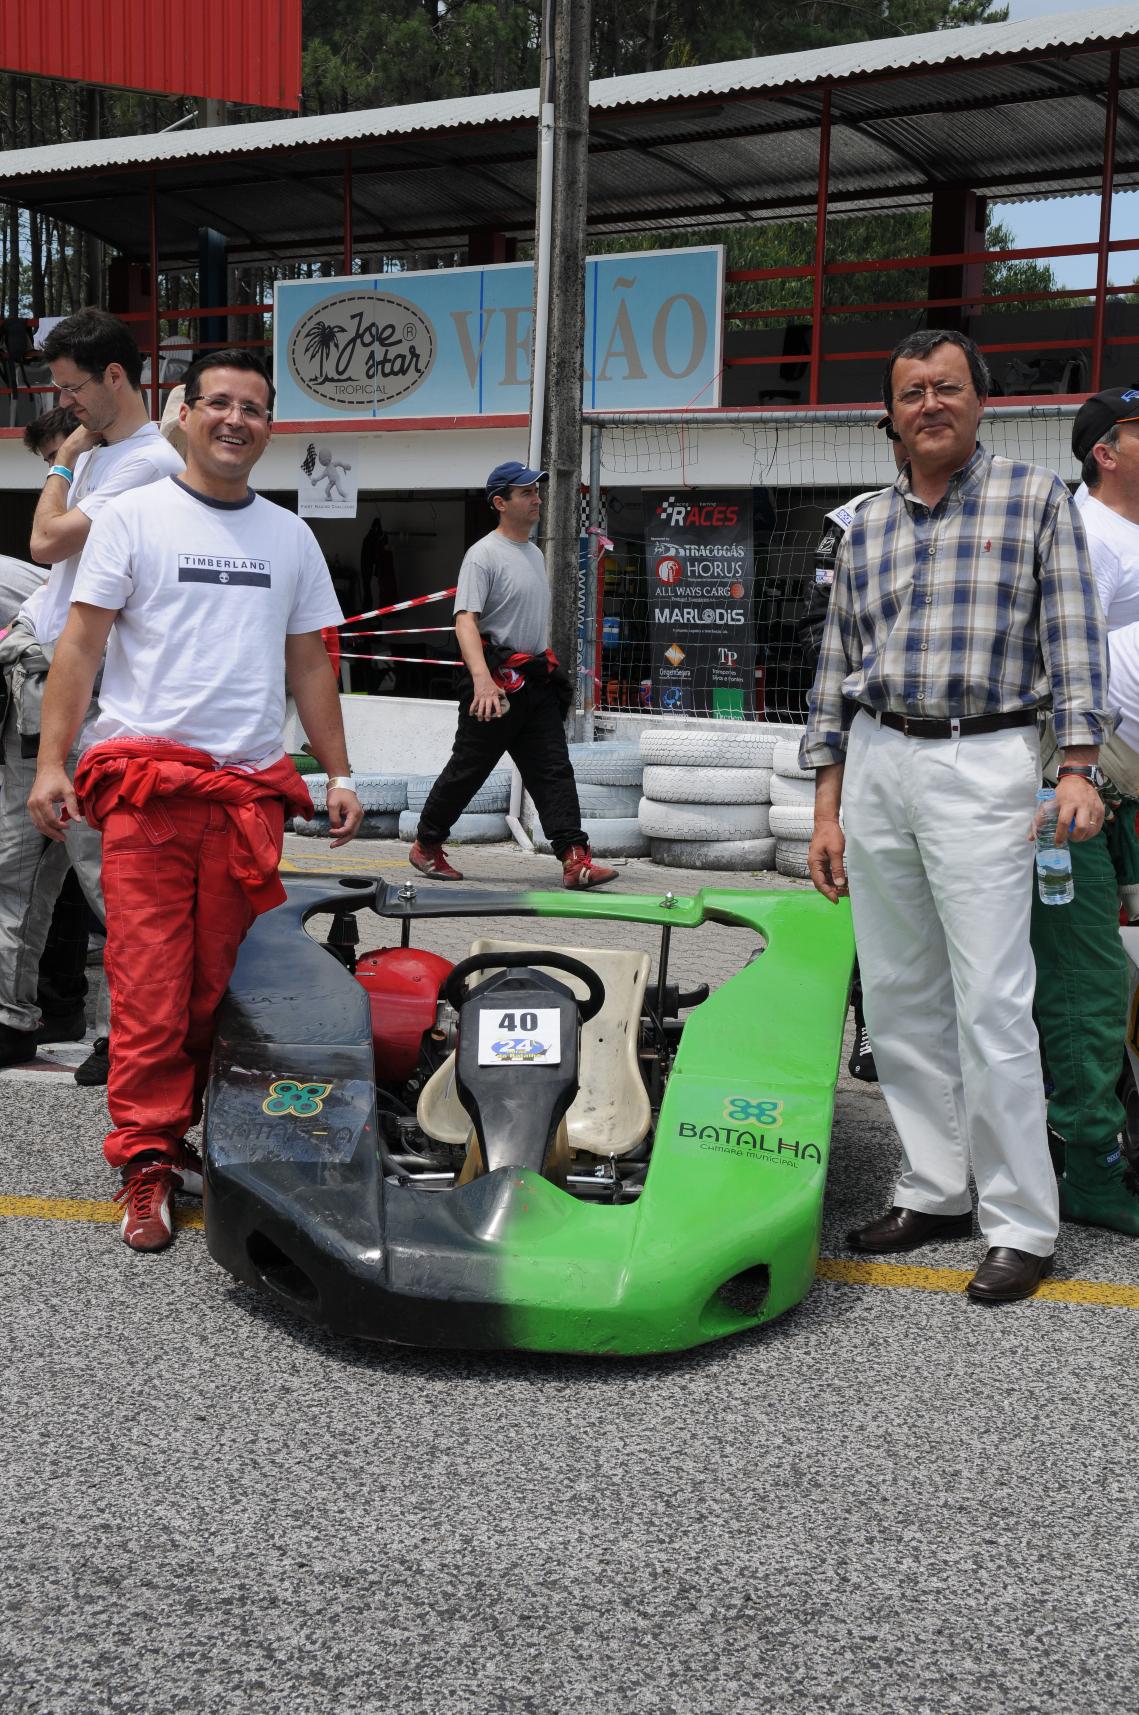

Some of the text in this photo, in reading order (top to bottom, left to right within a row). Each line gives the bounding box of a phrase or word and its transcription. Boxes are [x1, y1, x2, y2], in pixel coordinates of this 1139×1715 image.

[449, 276, 707, 390] VEÃO
[336, 311, 403, 376] Joe
[334, 385, 389, 395] TROPICAL
[184, 556, 265, 571] TIMBERLAND
[687, 561, 742, 577] HORUS
[655, 587, 674, 596] ALL
[676, 587, 702, 597] WAYS
[498, 1012, 538, 1032] 40
[679, 1122, 821, 1164] BATALHA
